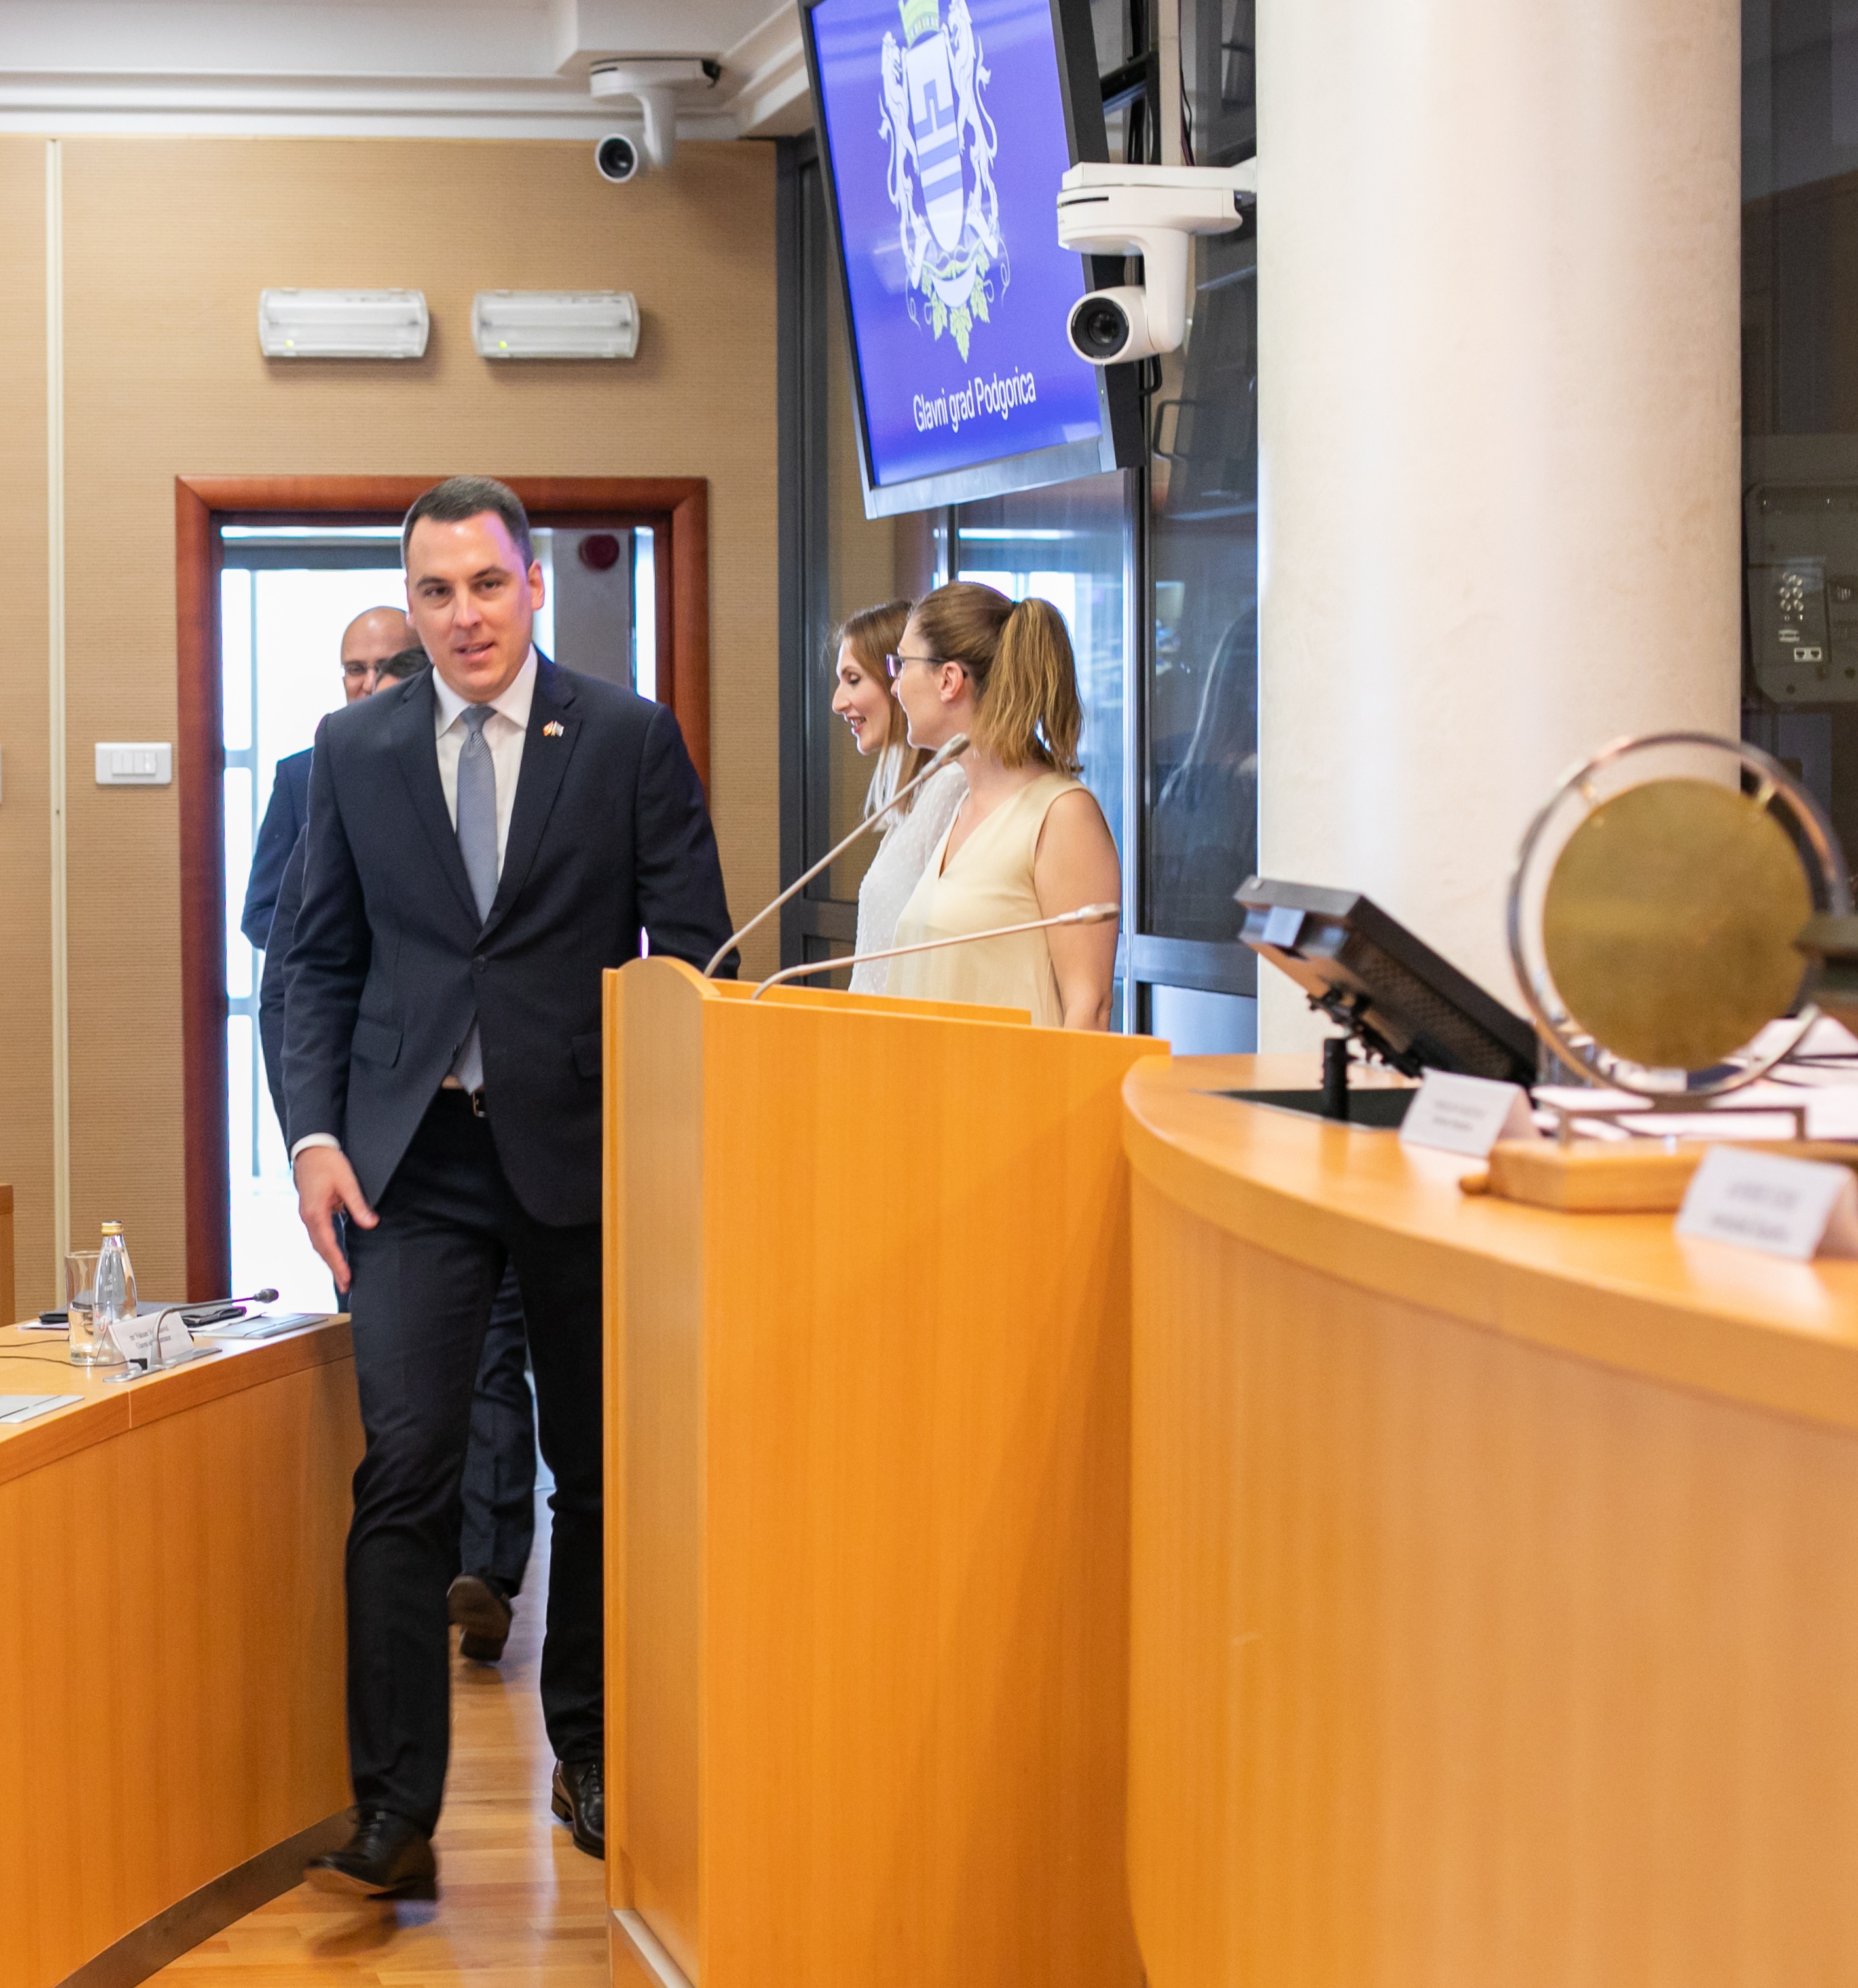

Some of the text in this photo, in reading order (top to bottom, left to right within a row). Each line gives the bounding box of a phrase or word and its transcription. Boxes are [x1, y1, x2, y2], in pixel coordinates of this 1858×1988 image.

[913, 365, 1036, 433] Glavni grad Podgorica
